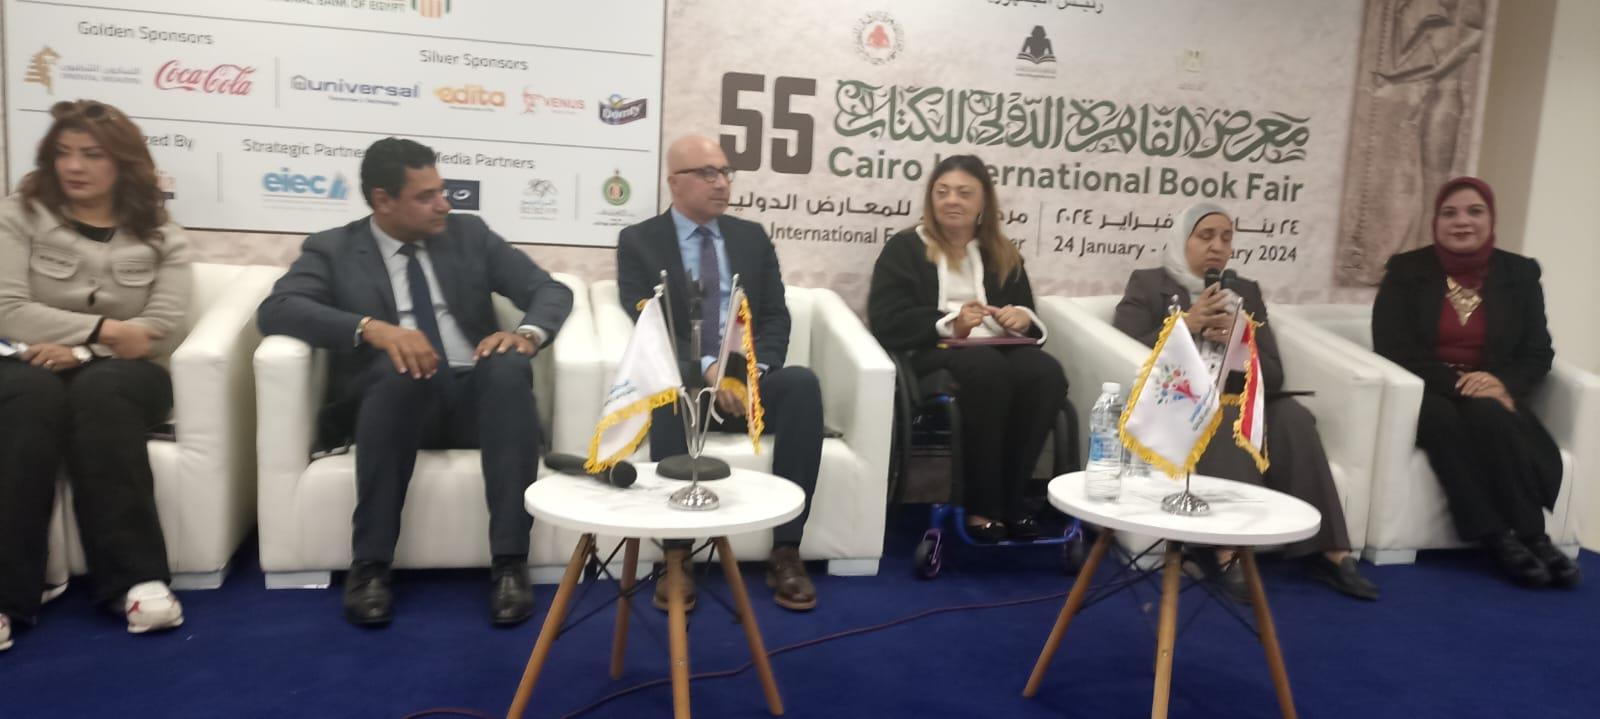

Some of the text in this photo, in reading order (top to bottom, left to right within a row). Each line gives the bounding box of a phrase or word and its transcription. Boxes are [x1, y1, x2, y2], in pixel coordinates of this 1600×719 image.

[77, 20, 214, 45] Golden Sponsors
[419, 49, 529, 71] Silver Sponsors
[308, 79, 420, 98] universal
[434, 85, 505, 107] edita
[719, 71, 817, 175] 55
[174, 135, 193, 150] By
[242, 138, 310, 157] Strategic
[475, 153, 536, 169] Partners
[263, 167, 328, 194] eiec
[828, 146, 923, 182] Cairo
[1158, 167, 1238, 201] Book
[1246, 173, 1304, 203] Fair
[727, 189, 797, 213] الدولي
[1054, 236, 1074, 253] 24
[1079, 238, 1145, 260] January
[1259, 246, 1297, 263] 2024
